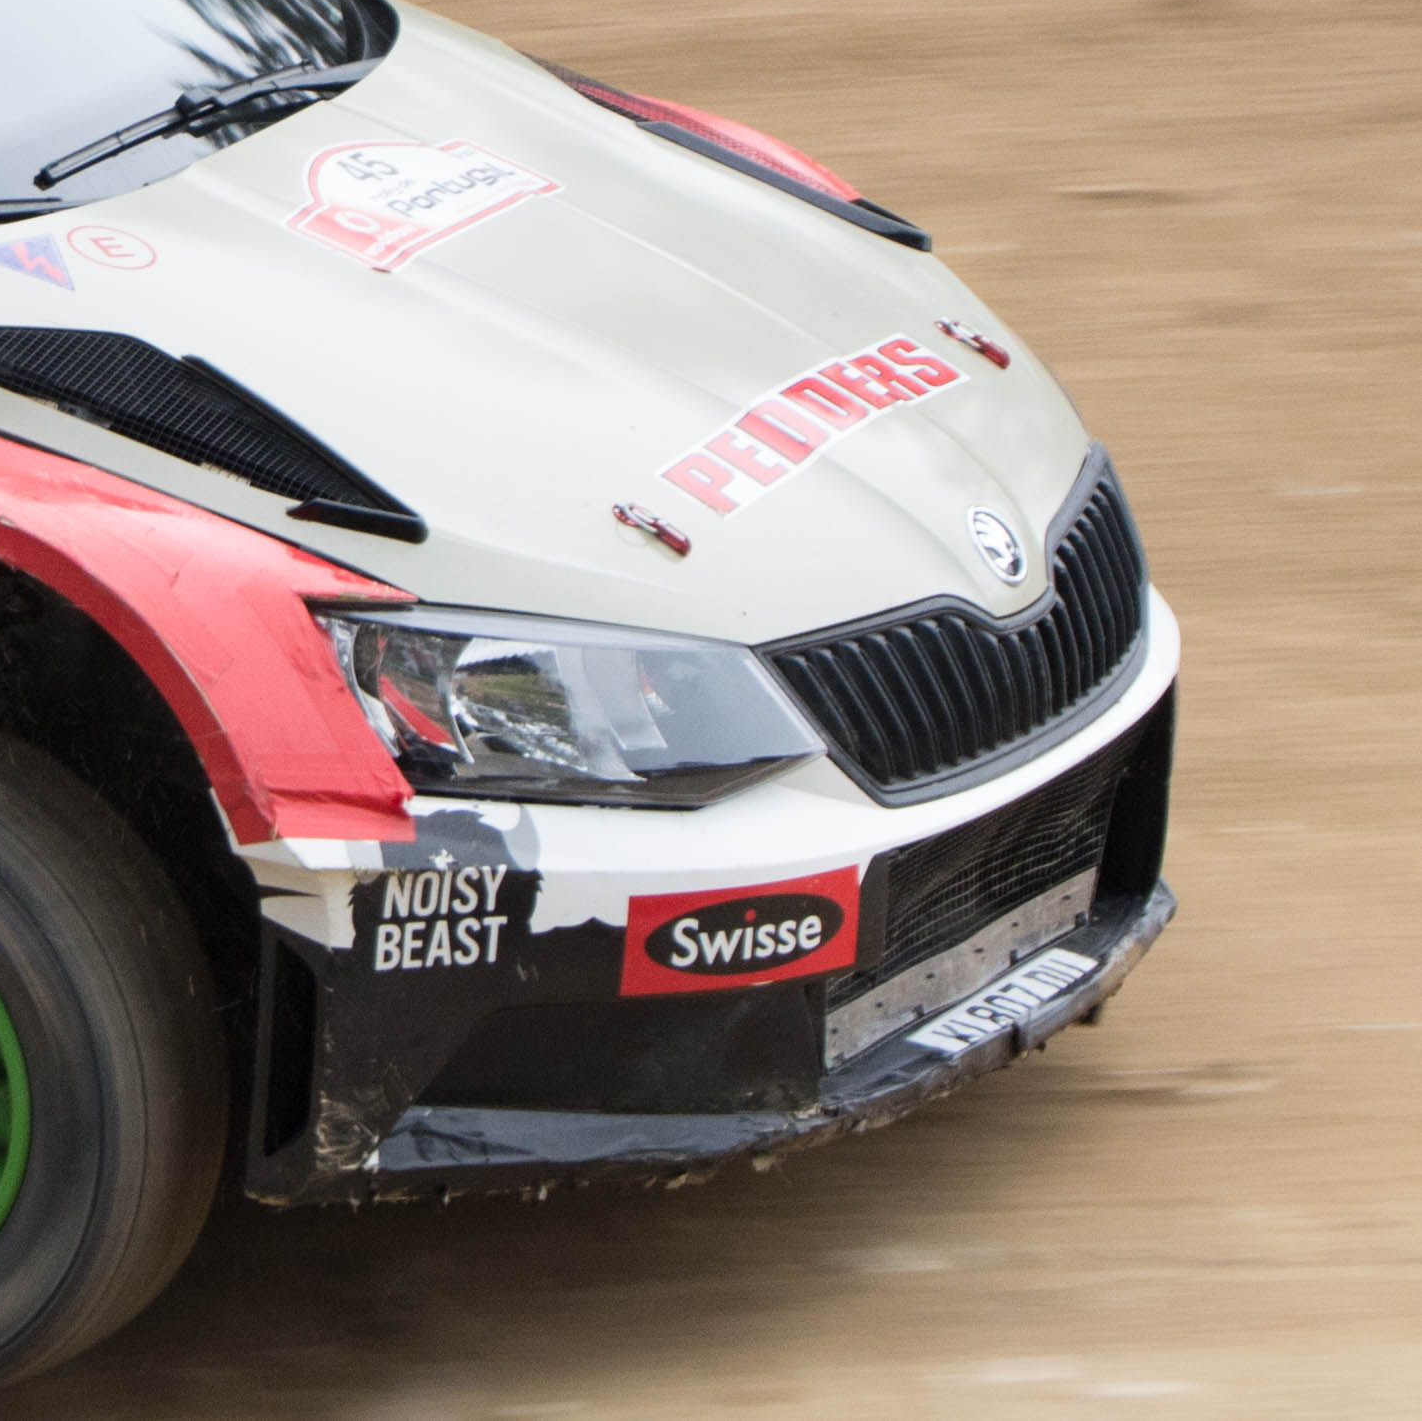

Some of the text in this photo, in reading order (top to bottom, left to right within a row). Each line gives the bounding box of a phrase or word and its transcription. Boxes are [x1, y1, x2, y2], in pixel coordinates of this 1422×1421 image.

[336, 151, 399, 183] 45
[662, 338, 962, 516] PEDDERS
[382, 863, 507, 920] NOISY
[375, 916, 508, 973] BEAST
[670, 908, 824, 969] Swisse
